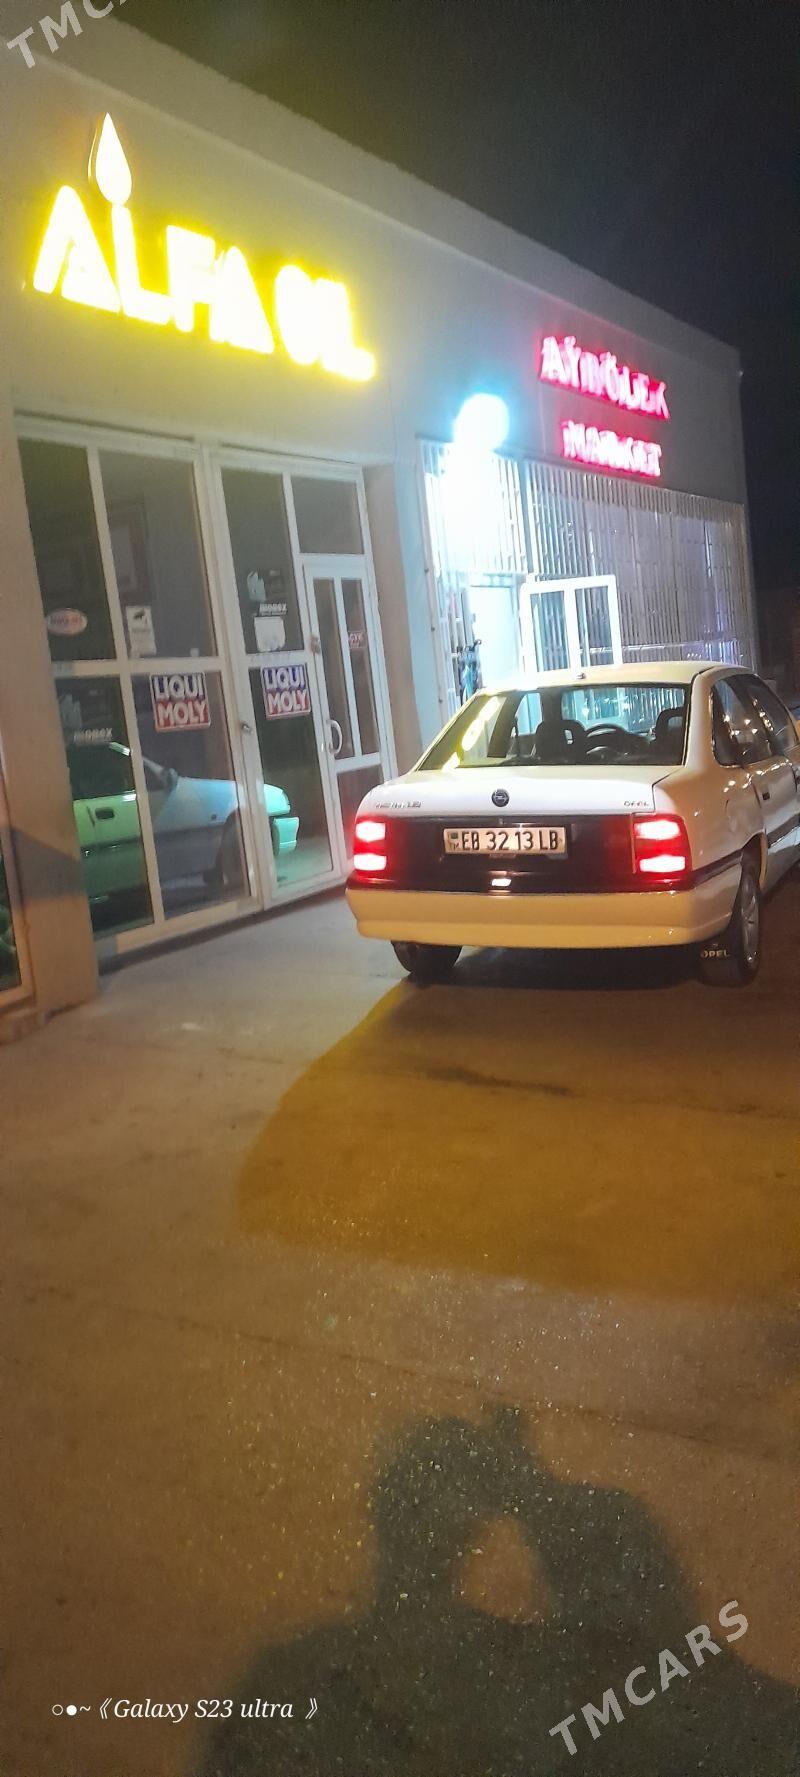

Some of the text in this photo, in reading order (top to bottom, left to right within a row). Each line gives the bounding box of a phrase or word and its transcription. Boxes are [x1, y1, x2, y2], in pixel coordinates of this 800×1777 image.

[33, 185, 375, 381] ALFA OIL
[153, 673, 205, 699] LIQUI
[264, 666, 305, 691] LIQUI
[156, 700, 207, 727] MOLY
[267, 689, 308, 715] MOLY
[461, 831, 480, 850] EB
[486, 831, 509, 850] 32
[515, 831, 534, 850] 13
[539, 831, 559, 850] LB
